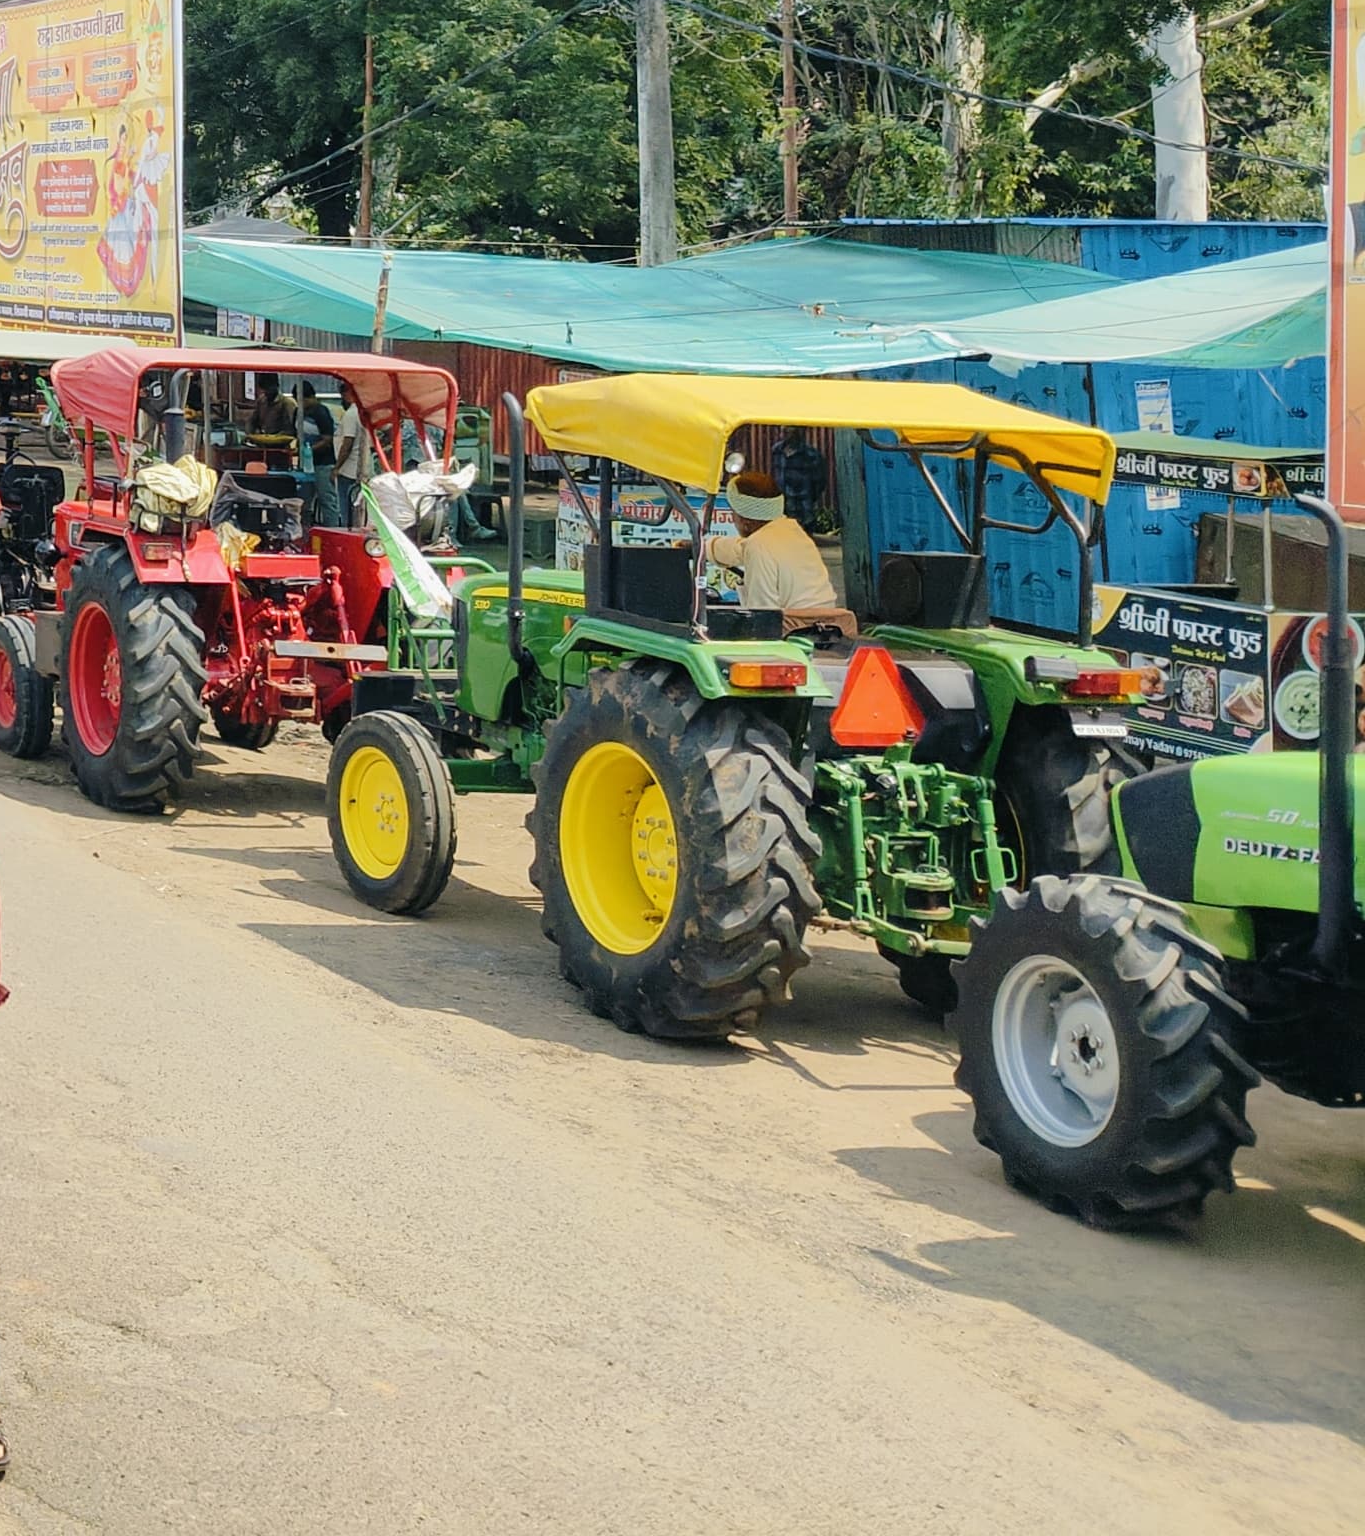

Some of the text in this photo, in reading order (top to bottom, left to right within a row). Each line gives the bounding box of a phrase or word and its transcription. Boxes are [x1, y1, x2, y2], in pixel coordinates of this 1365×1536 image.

[1158, 462, 1198, 481] फास्ट
[1202, 466, 1230, 489] फुड
[539, 593, 585, 608] JOHN DEERE
[1172, 618, 1223, 646] फास्ट
[1229, 627, 1262, 660] फुड
[1146, 737, 1174, 754] Yadav
[1223, 837, 1321, 864] DEUTZ-FA
